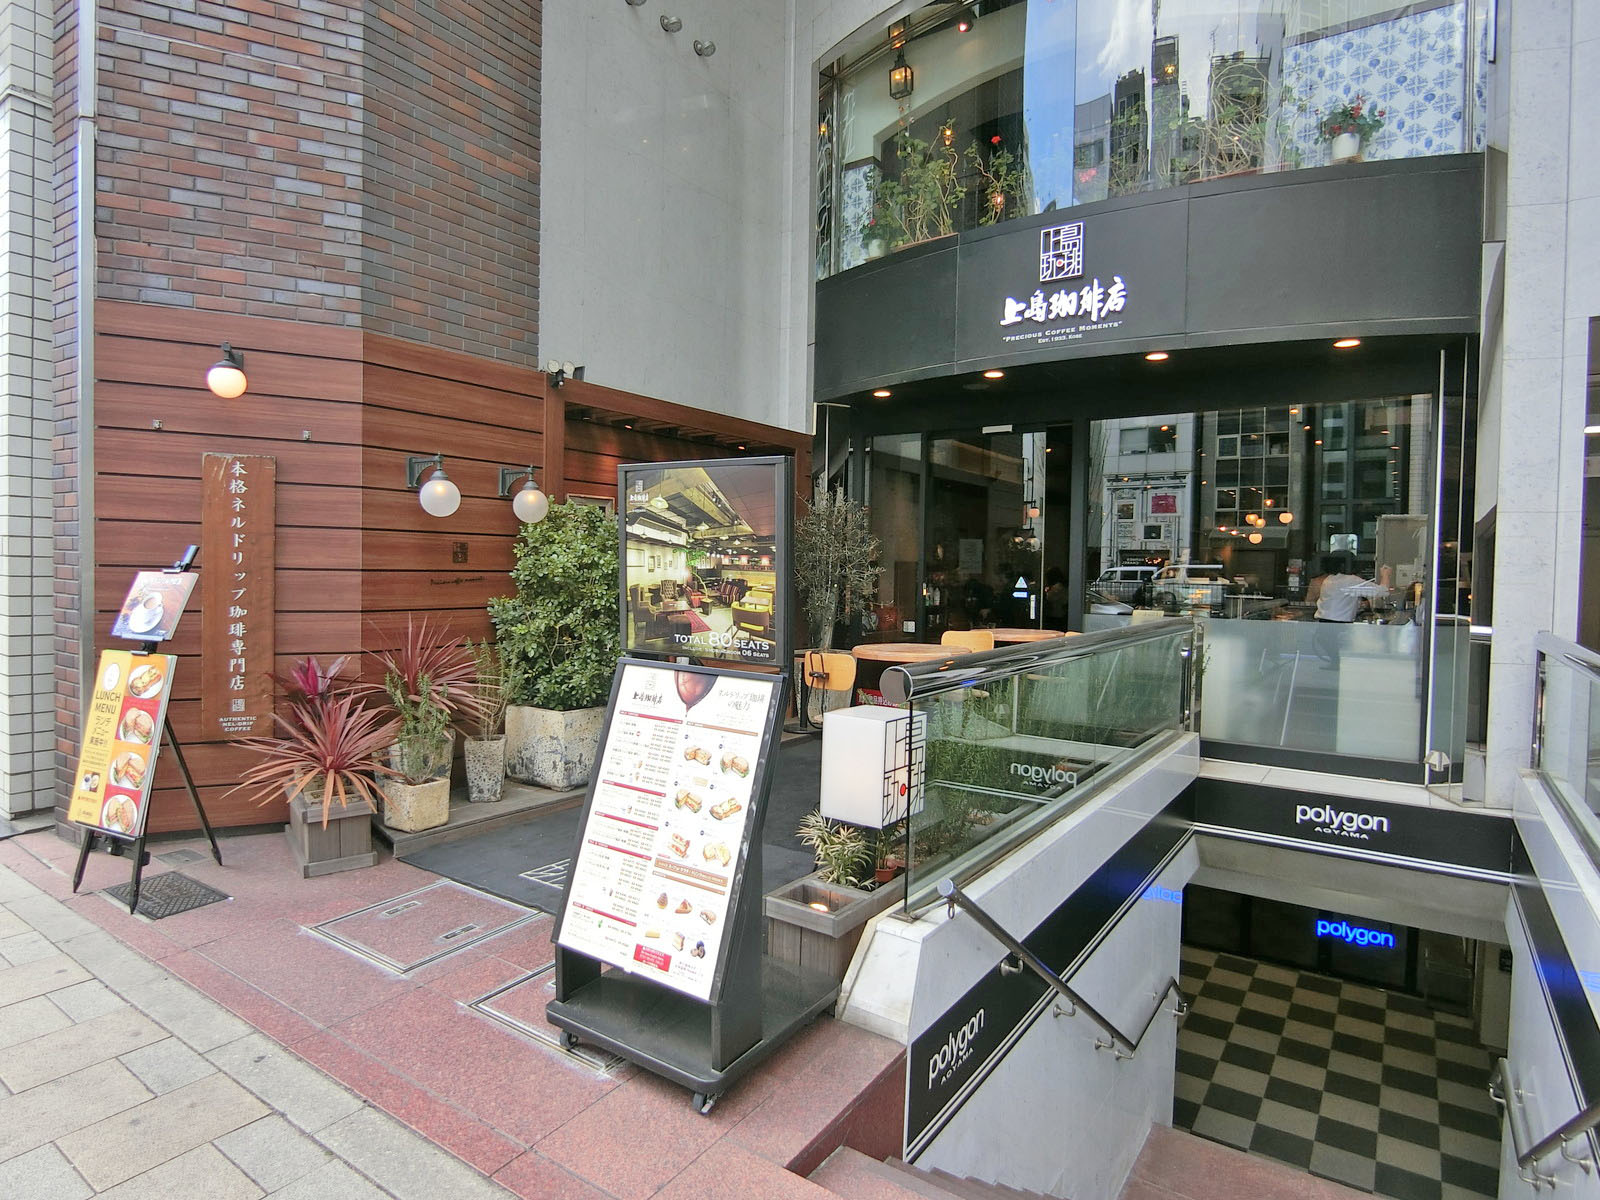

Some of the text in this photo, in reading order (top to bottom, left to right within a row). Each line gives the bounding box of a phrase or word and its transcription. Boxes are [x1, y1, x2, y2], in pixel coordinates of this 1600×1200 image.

[1000, 275, 1128, 326] 上島珈琲店
[228, 460, 249, 691] 本格ネルドリップ珈琲専門店
[674, 631, 770, 651] TOTAL 80 SEATS
[741, 649, 752, 657] 06
[94, 702, 117, 714] MENU
[95, 690, 121, 702] LUNCH
[1295, 804, 1391, 833] polygon
[1314, 826, 1369, 840] AOYAMA
[1316, 918, 1396, 949] polygon
[928, 1007, 986, 1089] polygon
[940, 1046, 975, 1086] AOYAMA
